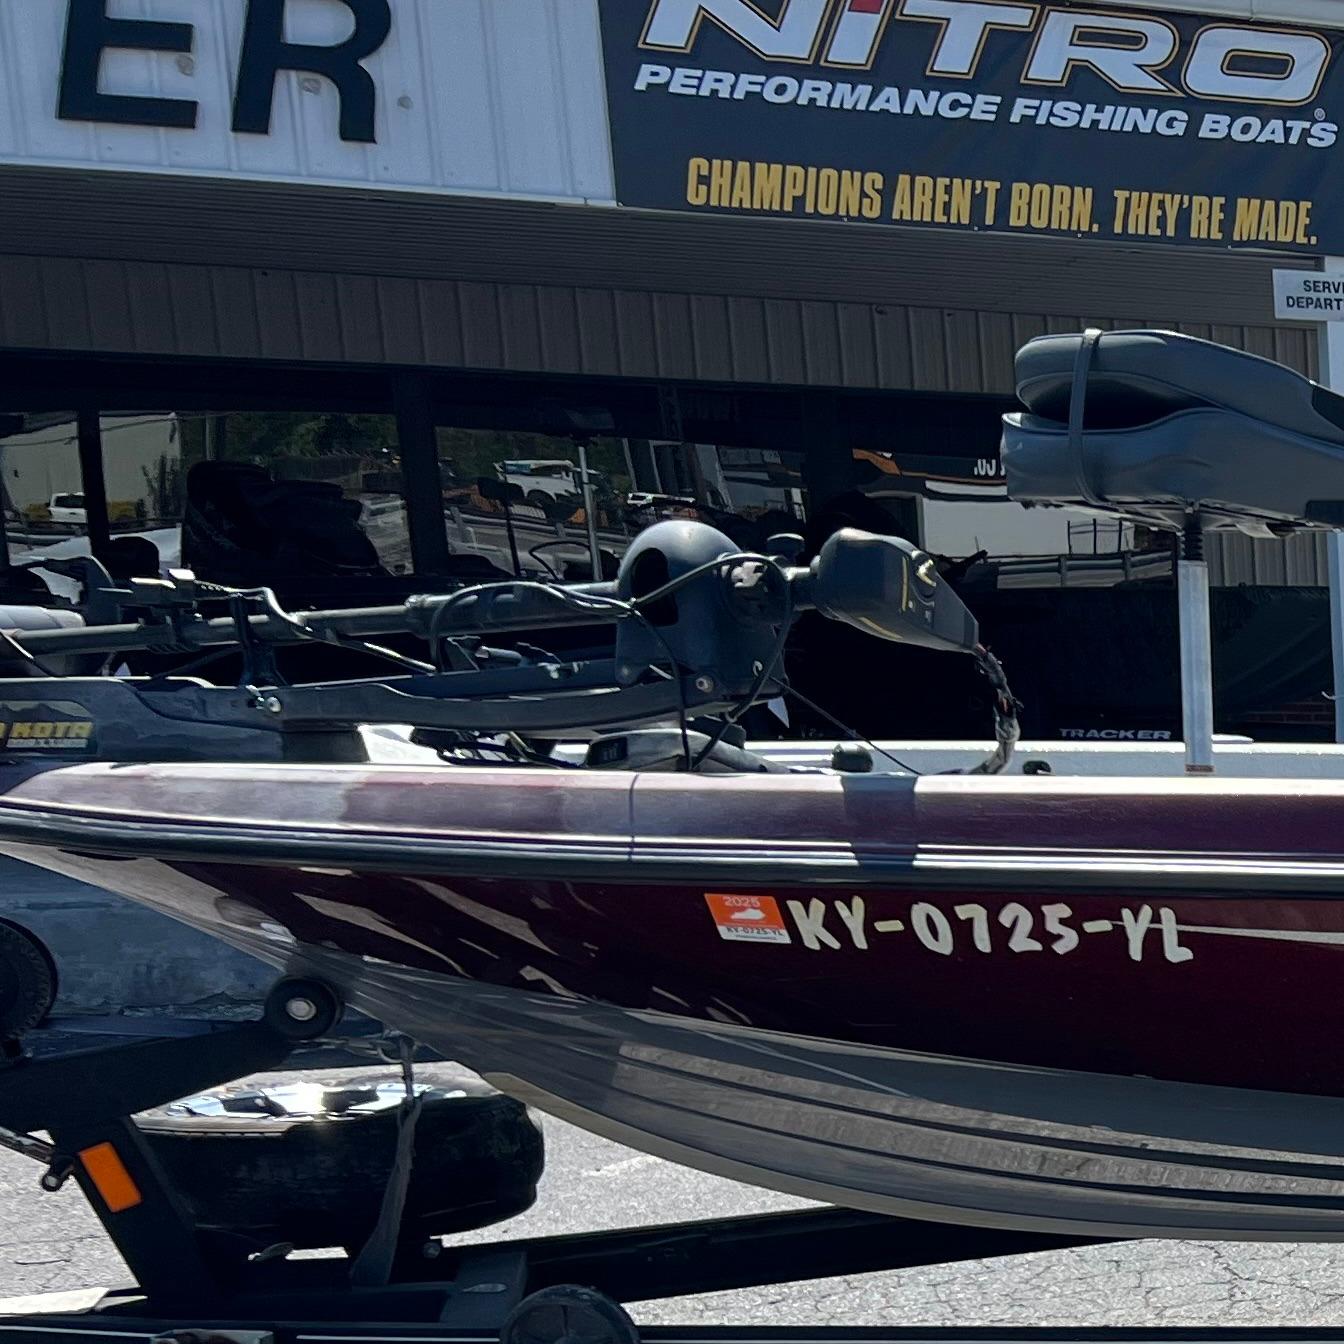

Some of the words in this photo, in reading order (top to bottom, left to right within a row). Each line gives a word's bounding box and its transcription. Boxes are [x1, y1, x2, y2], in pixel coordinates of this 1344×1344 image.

[634, 63, 1001, 121] PERFORMANCE
[1010, 99, 1188, 137] FISHING
[1199, 113, 1338, 148] BOATS
[686, 157, 884, 219] CHAMPIONS
[892, 174, 1000, 226] AREN'T
[1009, 182, 1099, 233] BORN.
[1113, 190, 1226, 240] THEY'RE
[1232, 198, 1317, 245] MADE.
[1060, 728, 1171, 740] TRACKER
[786, 895, 1194, 963] KY-0725-YL
